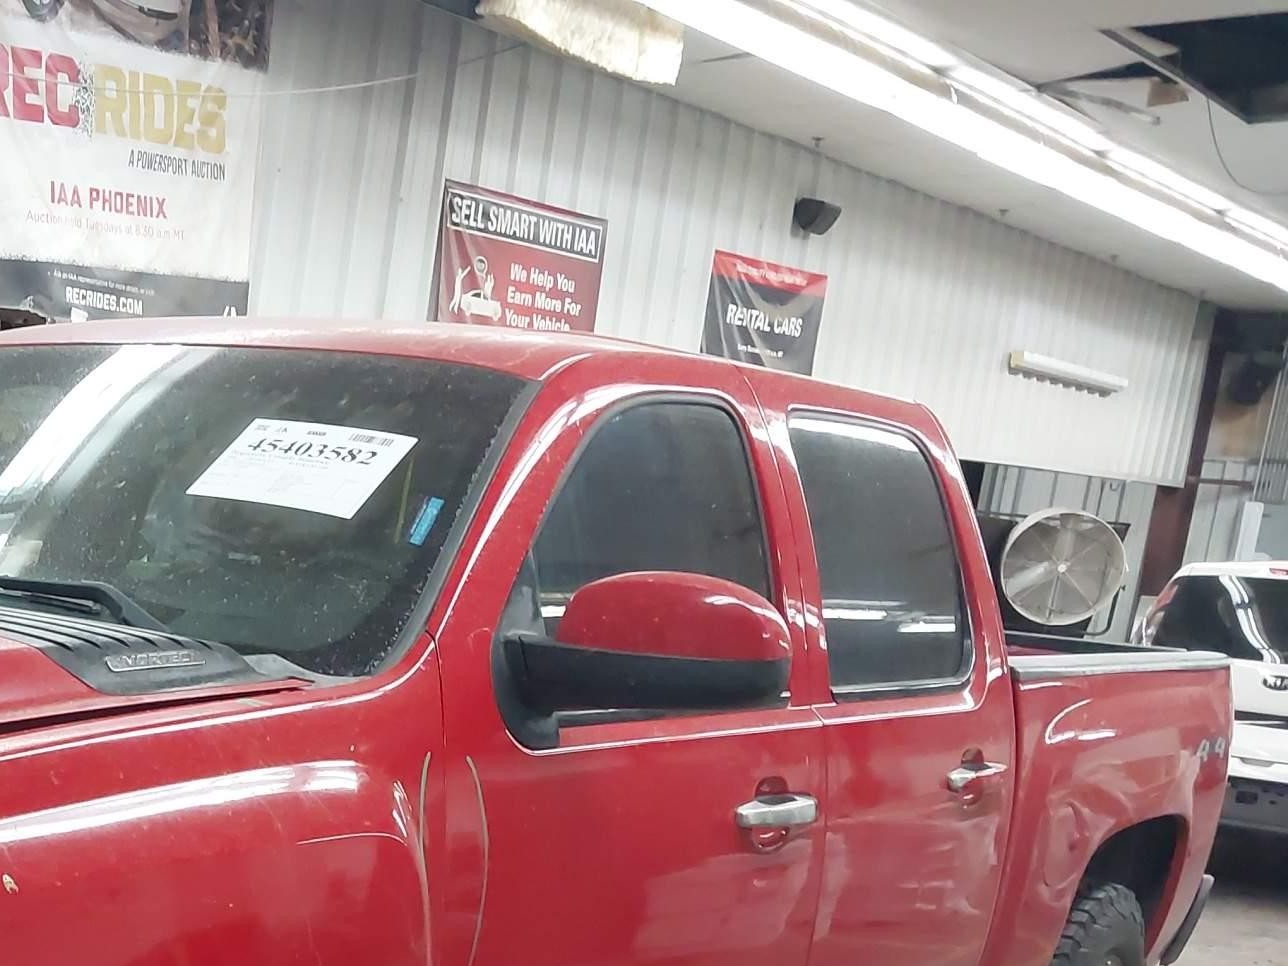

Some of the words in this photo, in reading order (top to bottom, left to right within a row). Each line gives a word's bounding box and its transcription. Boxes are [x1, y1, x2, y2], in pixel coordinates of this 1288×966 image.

[95, 63, 228, 154] RIDES
[128, 149, 134, 167] A
[136, 150, 188, 176] POWERSPORT
[191, 160, 226, 181] AUCTION
[50, 181, 82, 208] IAA
[89, 187, 168, 219] PHOENIX
[25, 209, 61, 225] Auction
[451, 196, 485, 229] SELL
[487, 206, 538, 240] SMART
[539, 217, 574, 250] WITH
[574, 227, 597, 256] IAA
[510, 263, 527, 283] We
[530, 265, 553, 289] Help
[556, 272, 575, 293] You
[65, 286, 143, 316] RECRIDES.COM
[507, 286, 532, 306] Earn
[534, 291, 562, 312] More
[563, 299, 582, 317] For
[505, 308, 530, 328] Your
[726, 304, 771, 332] RENTAL
[773, 317, 803, 338] CARS
[247, 438, 378, 465] 45403582
[1196, 737, 1226, 762] 44
